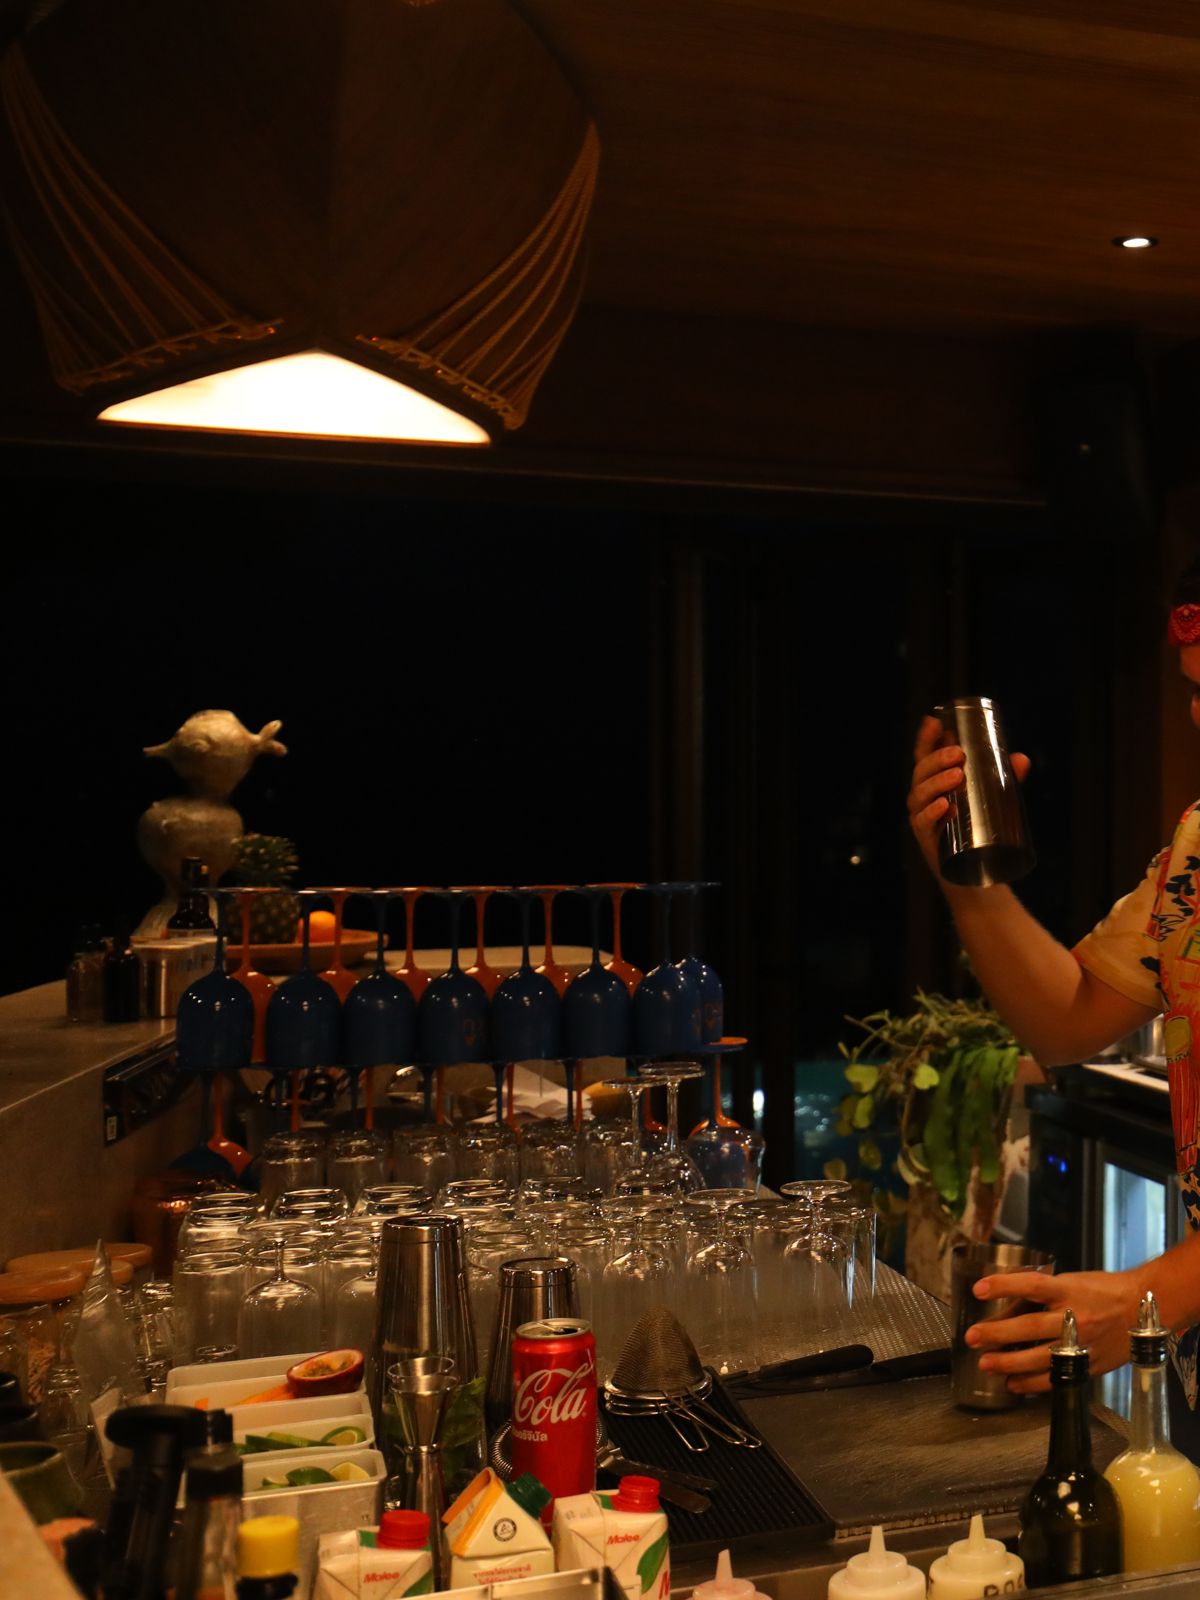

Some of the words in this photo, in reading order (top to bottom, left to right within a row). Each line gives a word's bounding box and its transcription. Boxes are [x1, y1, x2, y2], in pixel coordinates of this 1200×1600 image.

[514, 1357, 594, 1426] Cola
[607, 1534, 641, 1545] Malee
[363, 1571, 400, 1584] Malee
